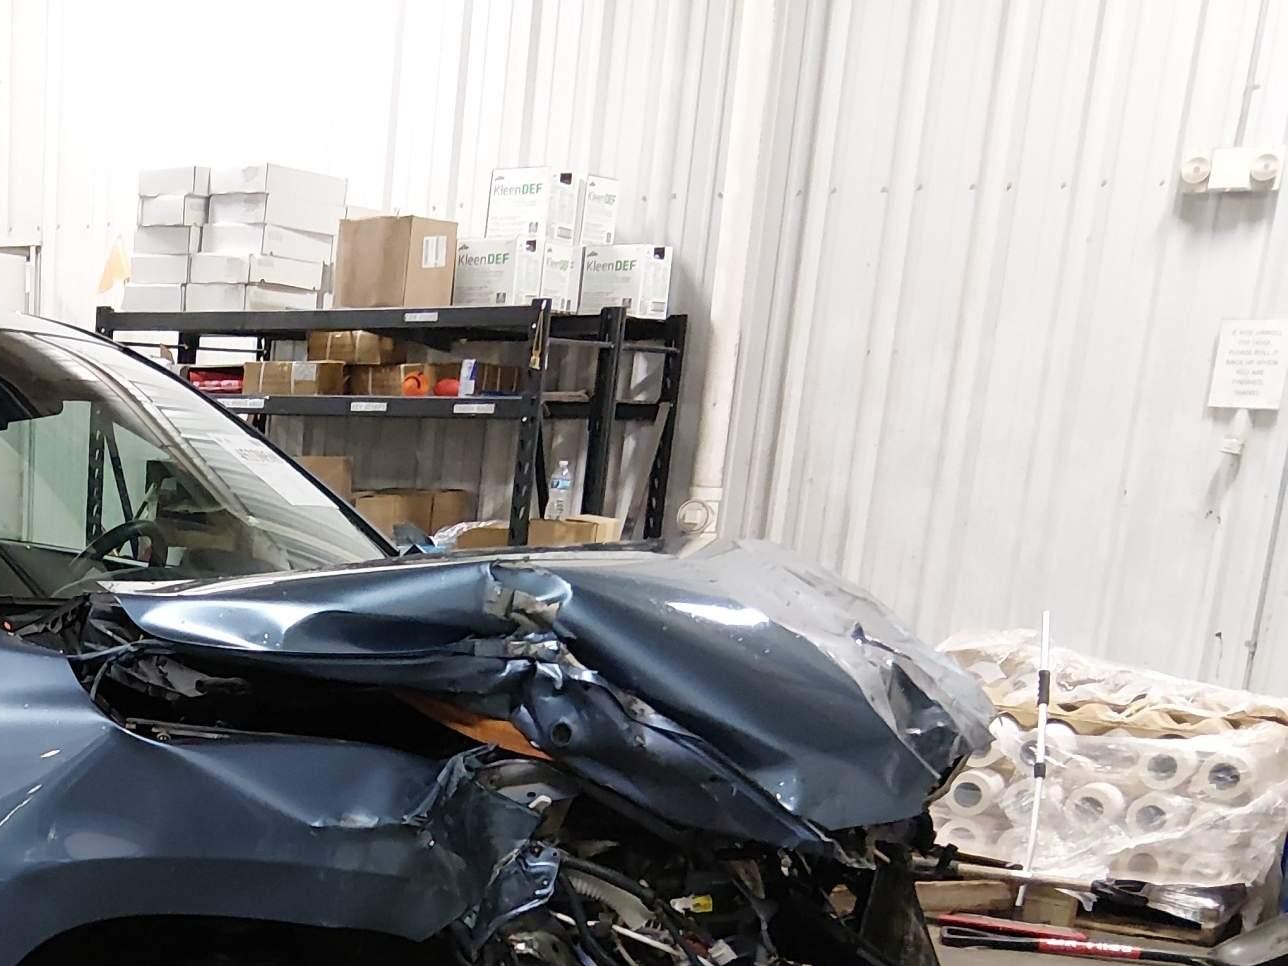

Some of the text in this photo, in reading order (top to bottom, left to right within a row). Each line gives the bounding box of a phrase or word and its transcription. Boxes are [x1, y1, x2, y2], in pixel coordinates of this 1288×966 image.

[494, 183, 543, 197] KleenDEF
[457, 251, 510, 266] KleenDEF
[586, 259, 638, 273] KleenDEF
